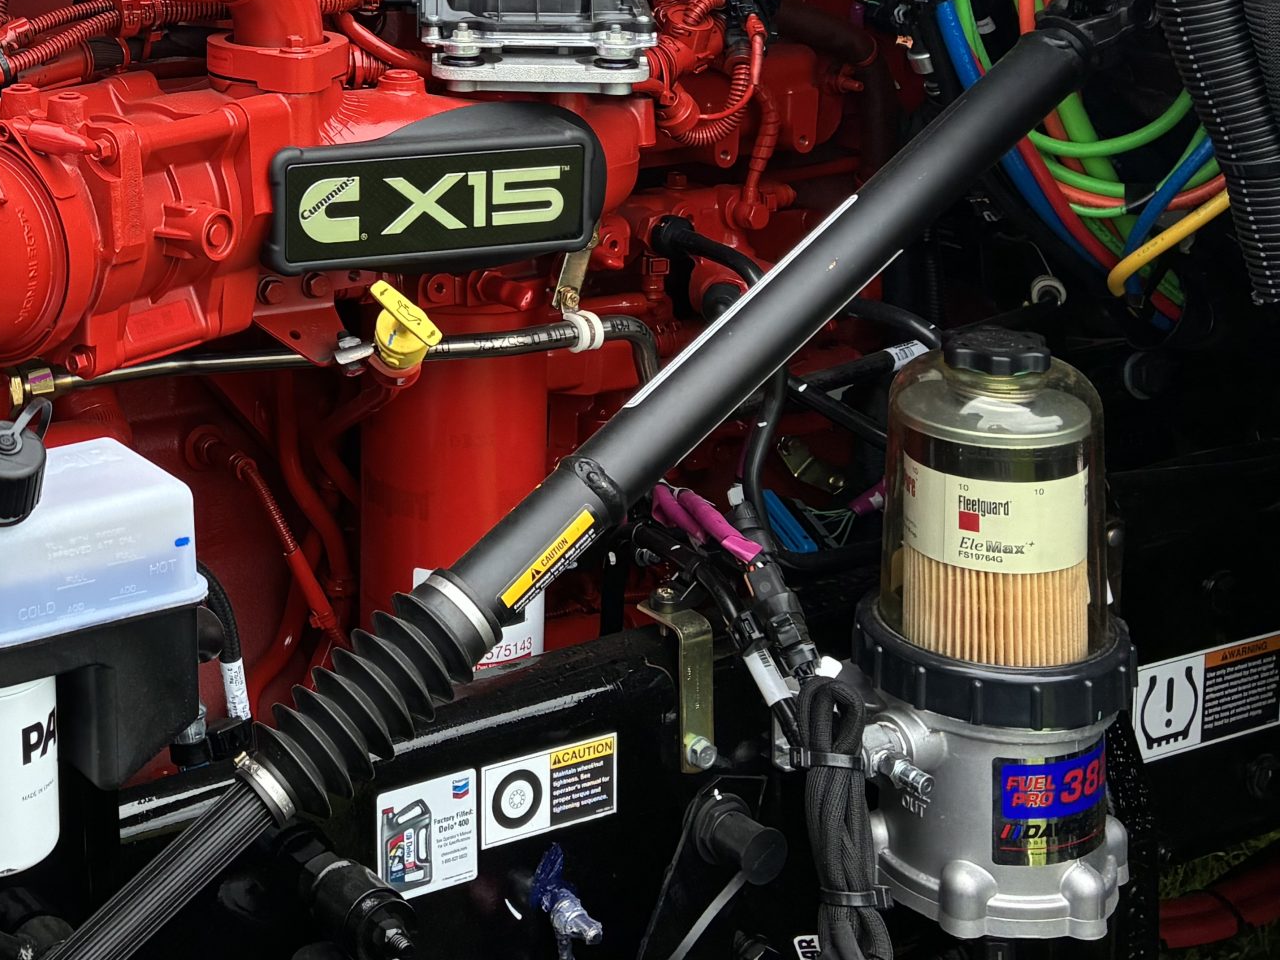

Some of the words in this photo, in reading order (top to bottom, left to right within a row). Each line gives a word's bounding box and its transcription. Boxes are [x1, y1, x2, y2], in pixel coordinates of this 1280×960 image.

[300, 176, 355, 220] Cummins
[381, 166, 564, 235] X15
[958, 494, 1009, 517] Fleetguard
[541, 537, 568, 567] CAUTION
[149, 558, 177, 576] HOT
[18, 601, 56, 621] COLD
[1228, 641, 1268, 659] WARNING
[562, 740, 612, 762] CAUTION
[1007, 775, 1056, 791] FUEL
[901, 794, 928, 818] OUT
[1011, 792, 1055, 808] PRO
